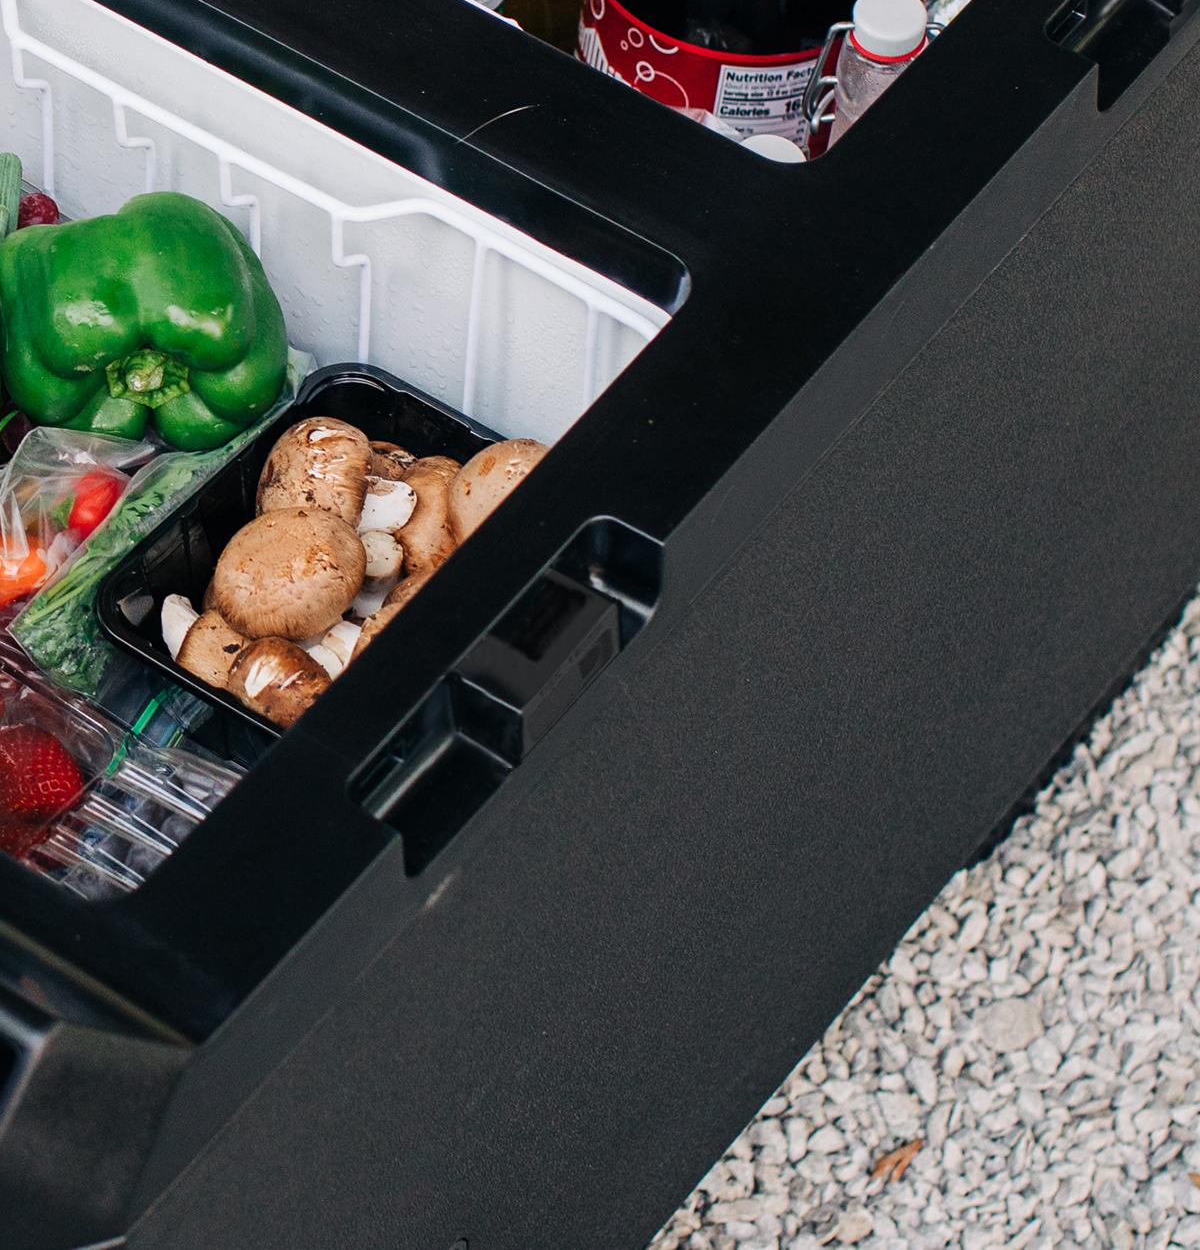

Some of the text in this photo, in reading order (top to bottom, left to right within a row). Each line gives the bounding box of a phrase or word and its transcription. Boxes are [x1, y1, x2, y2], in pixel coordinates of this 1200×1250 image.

[726, 67, 814, 83] Nutrition Fact
[720, 105, 771, 117] Calories
[785, 99, 802, 113] 16
